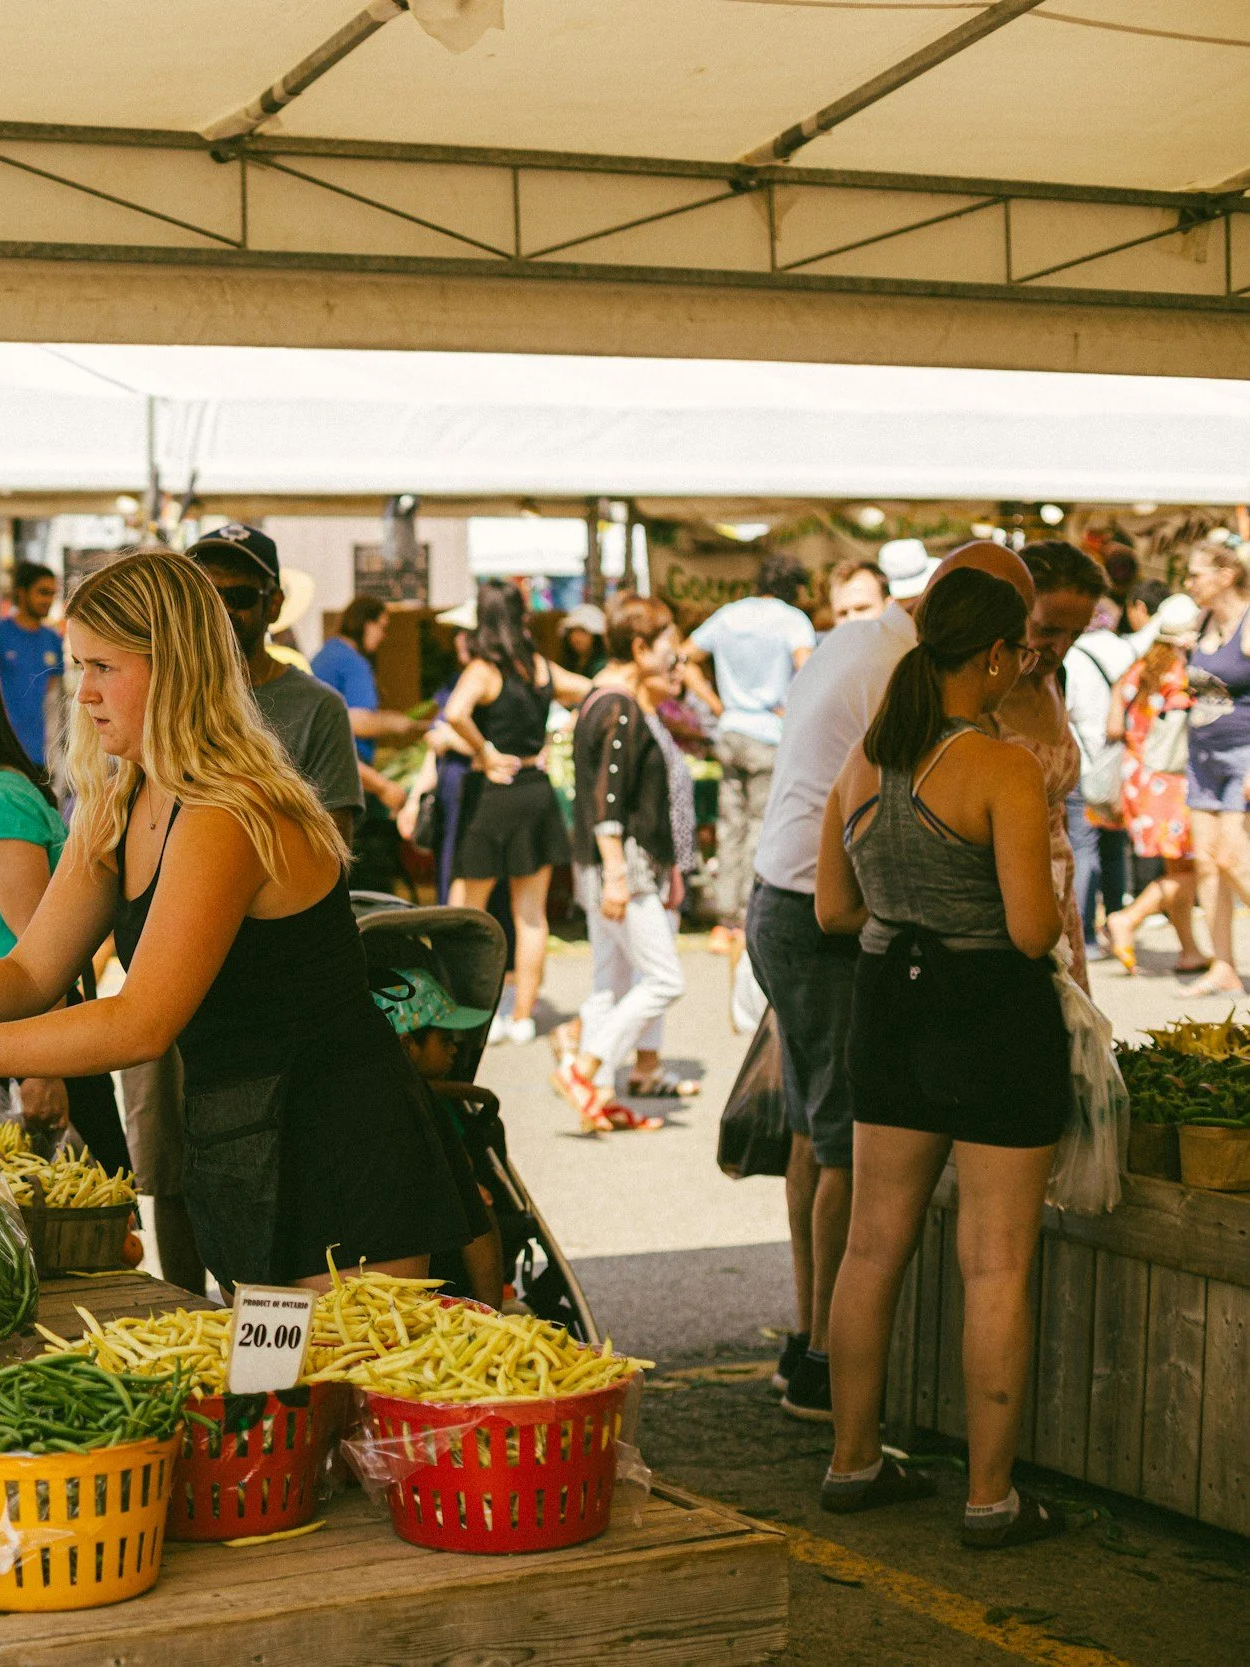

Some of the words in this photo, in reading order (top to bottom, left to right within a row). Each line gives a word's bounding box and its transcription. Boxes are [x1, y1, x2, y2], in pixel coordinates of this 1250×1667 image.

[243, 1299, 271, 1308] PRODUCT
[272, 1300, 281, 1308] OF
[282, 1301, 308, 1309] ONTARIO
[238, 1322, 302, 1349] 20.00
